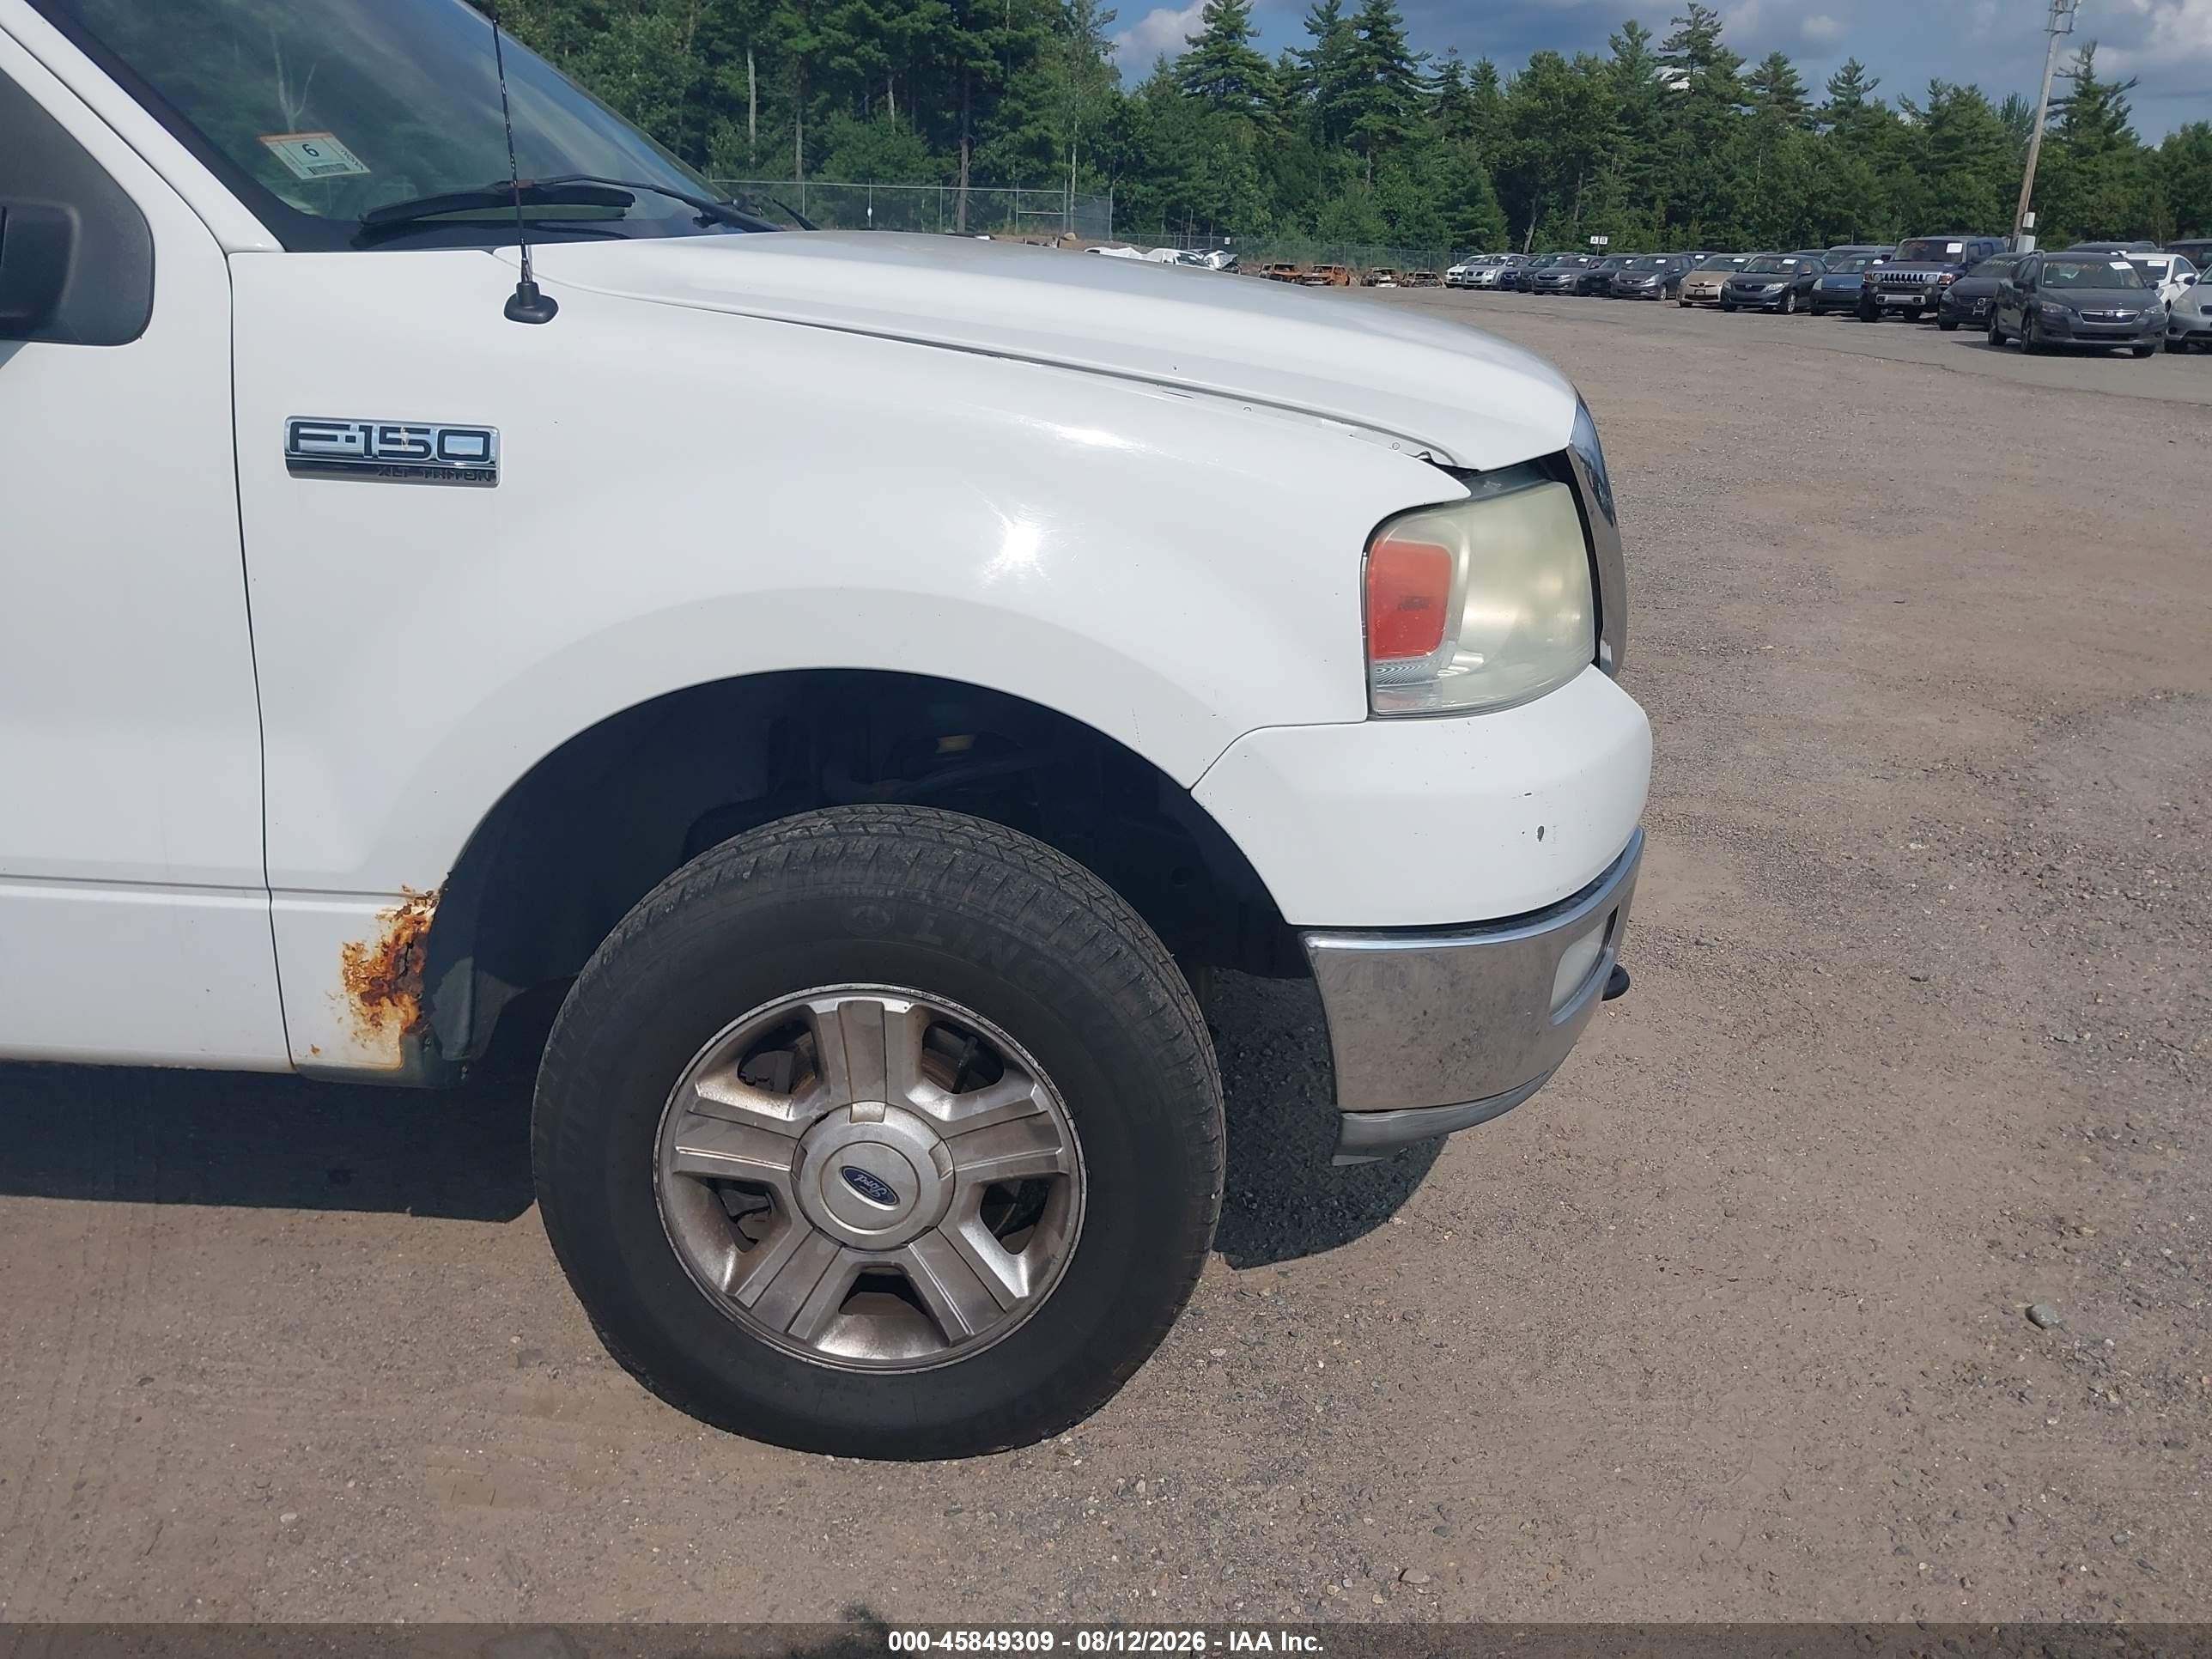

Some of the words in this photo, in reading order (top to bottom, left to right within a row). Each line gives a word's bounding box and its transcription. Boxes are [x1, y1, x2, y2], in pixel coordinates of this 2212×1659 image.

[289, 421, 491, 461] F-150
[378, 465, 409, 477] XLT
[422, 468, 495, 482] TRITON
[854, 1174, 888, 1197] Ford
